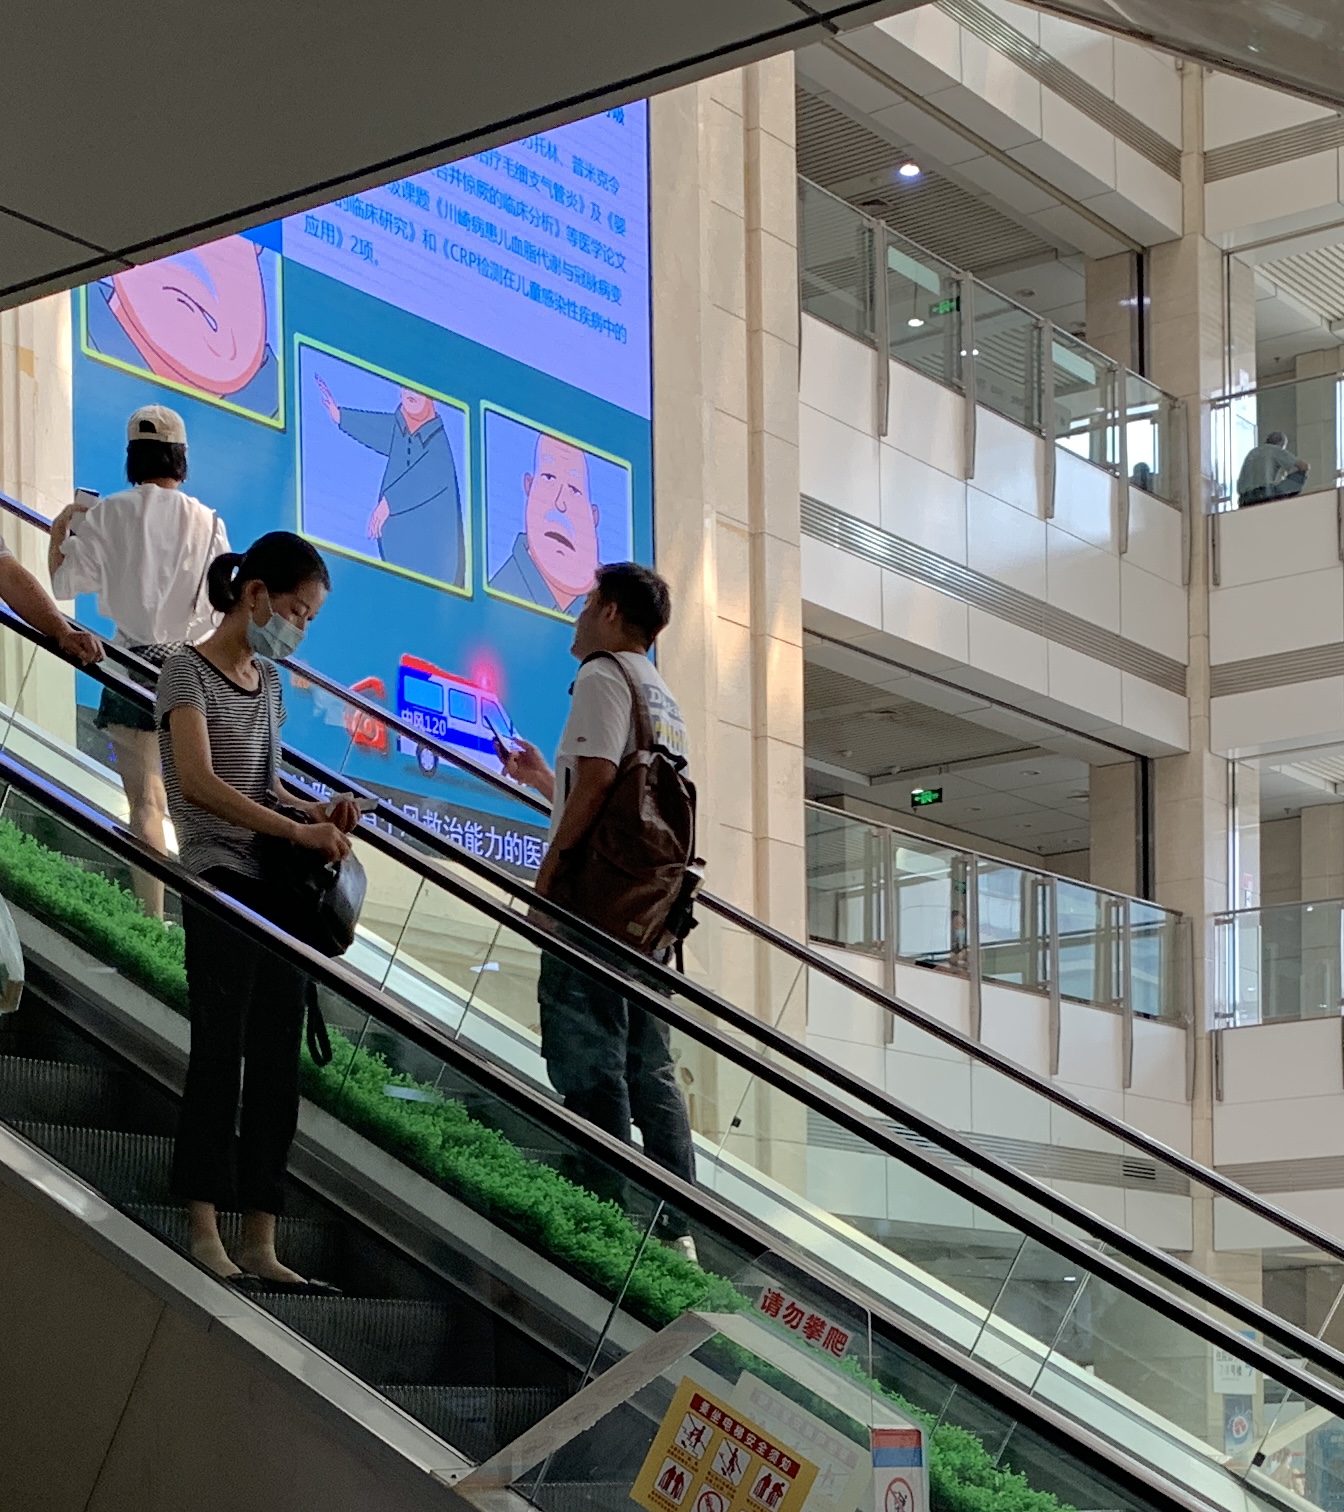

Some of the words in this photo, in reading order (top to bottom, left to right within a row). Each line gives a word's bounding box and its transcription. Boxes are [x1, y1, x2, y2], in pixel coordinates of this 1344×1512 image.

[430, 164, 628, 274] 合并惊厥的临床分析》等医学论文
[761, 1288, 849, 1358] 请勿攀爬
[698, 1400, 793, 1473] 乘坐电梯安全须知
